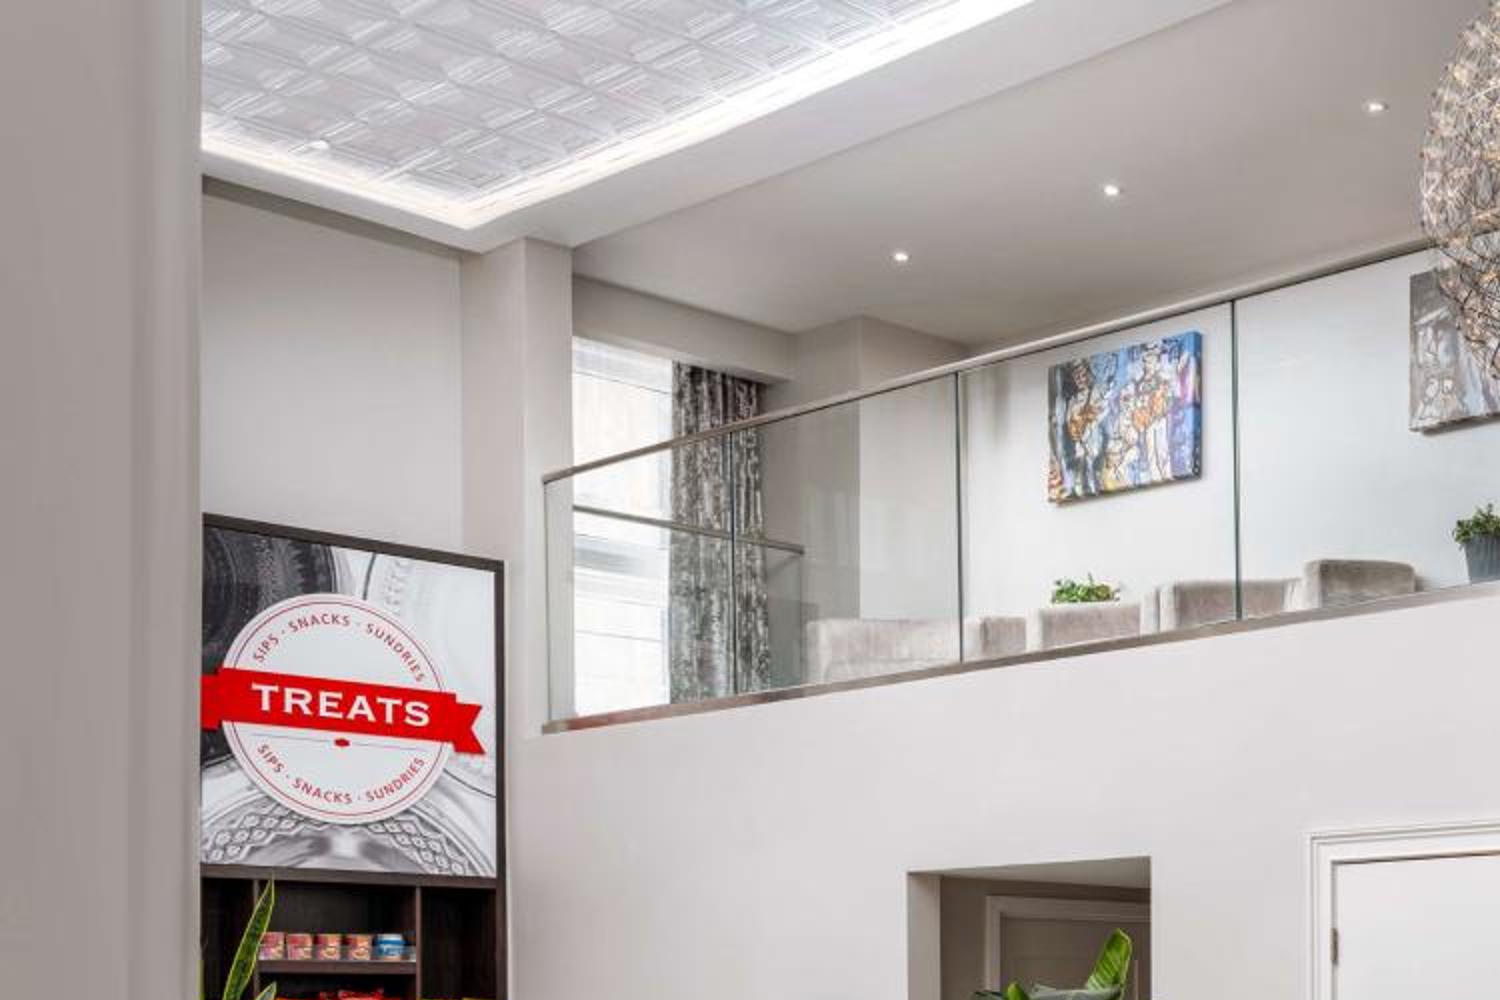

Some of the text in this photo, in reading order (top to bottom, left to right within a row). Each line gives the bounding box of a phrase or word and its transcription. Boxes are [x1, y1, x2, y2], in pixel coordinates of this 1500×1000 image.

[253, 613, 426, 682] SIPS SNACKS SUNDRIES
[251, 682, 431, 727] TREATS
[257, 744, 425, 804] SIPS SNACKS SUNDRIES
